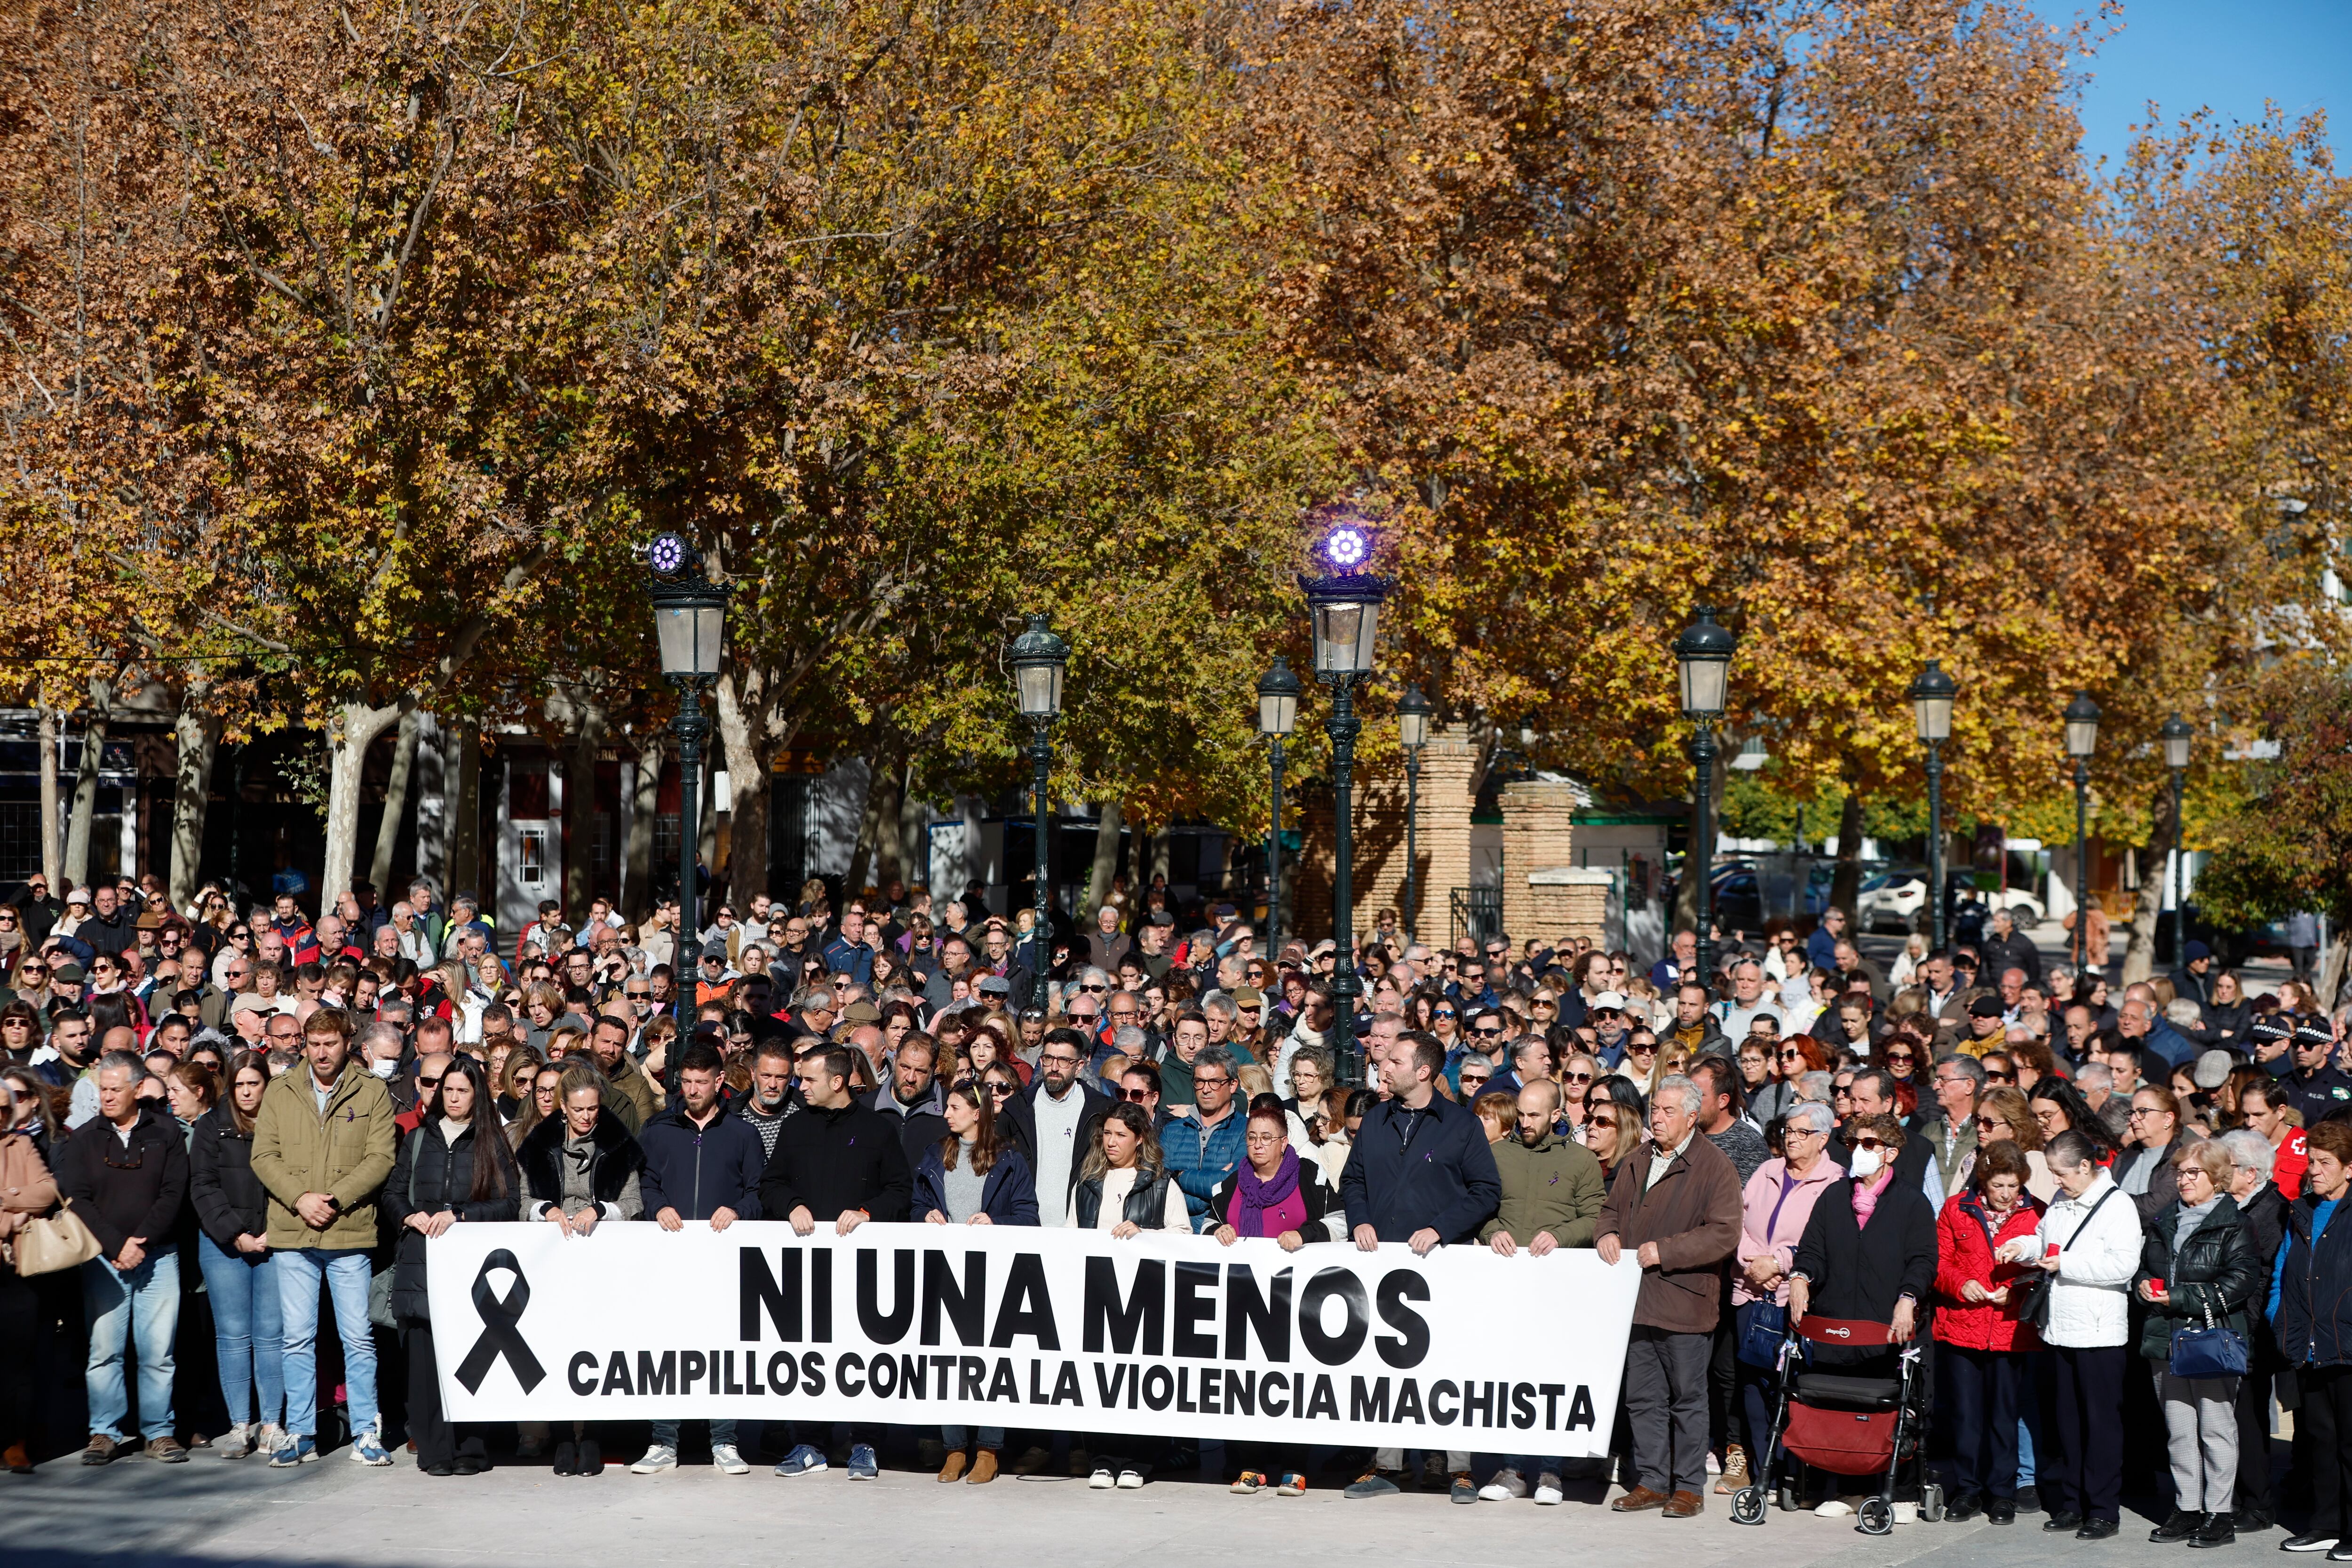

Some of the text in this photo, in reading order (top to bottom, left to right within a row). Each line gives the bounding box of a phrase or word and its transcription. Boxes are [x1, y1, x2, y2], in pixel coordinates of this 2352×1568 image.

[740, 1247, 1430, 1369] NI UNA MENOS
[1825, 1328, 1848, 1336] playcare
[568, 1350, 1596, 1433] CAMPILLOS CONTRA LA VIOLENCIA MACHISTA
